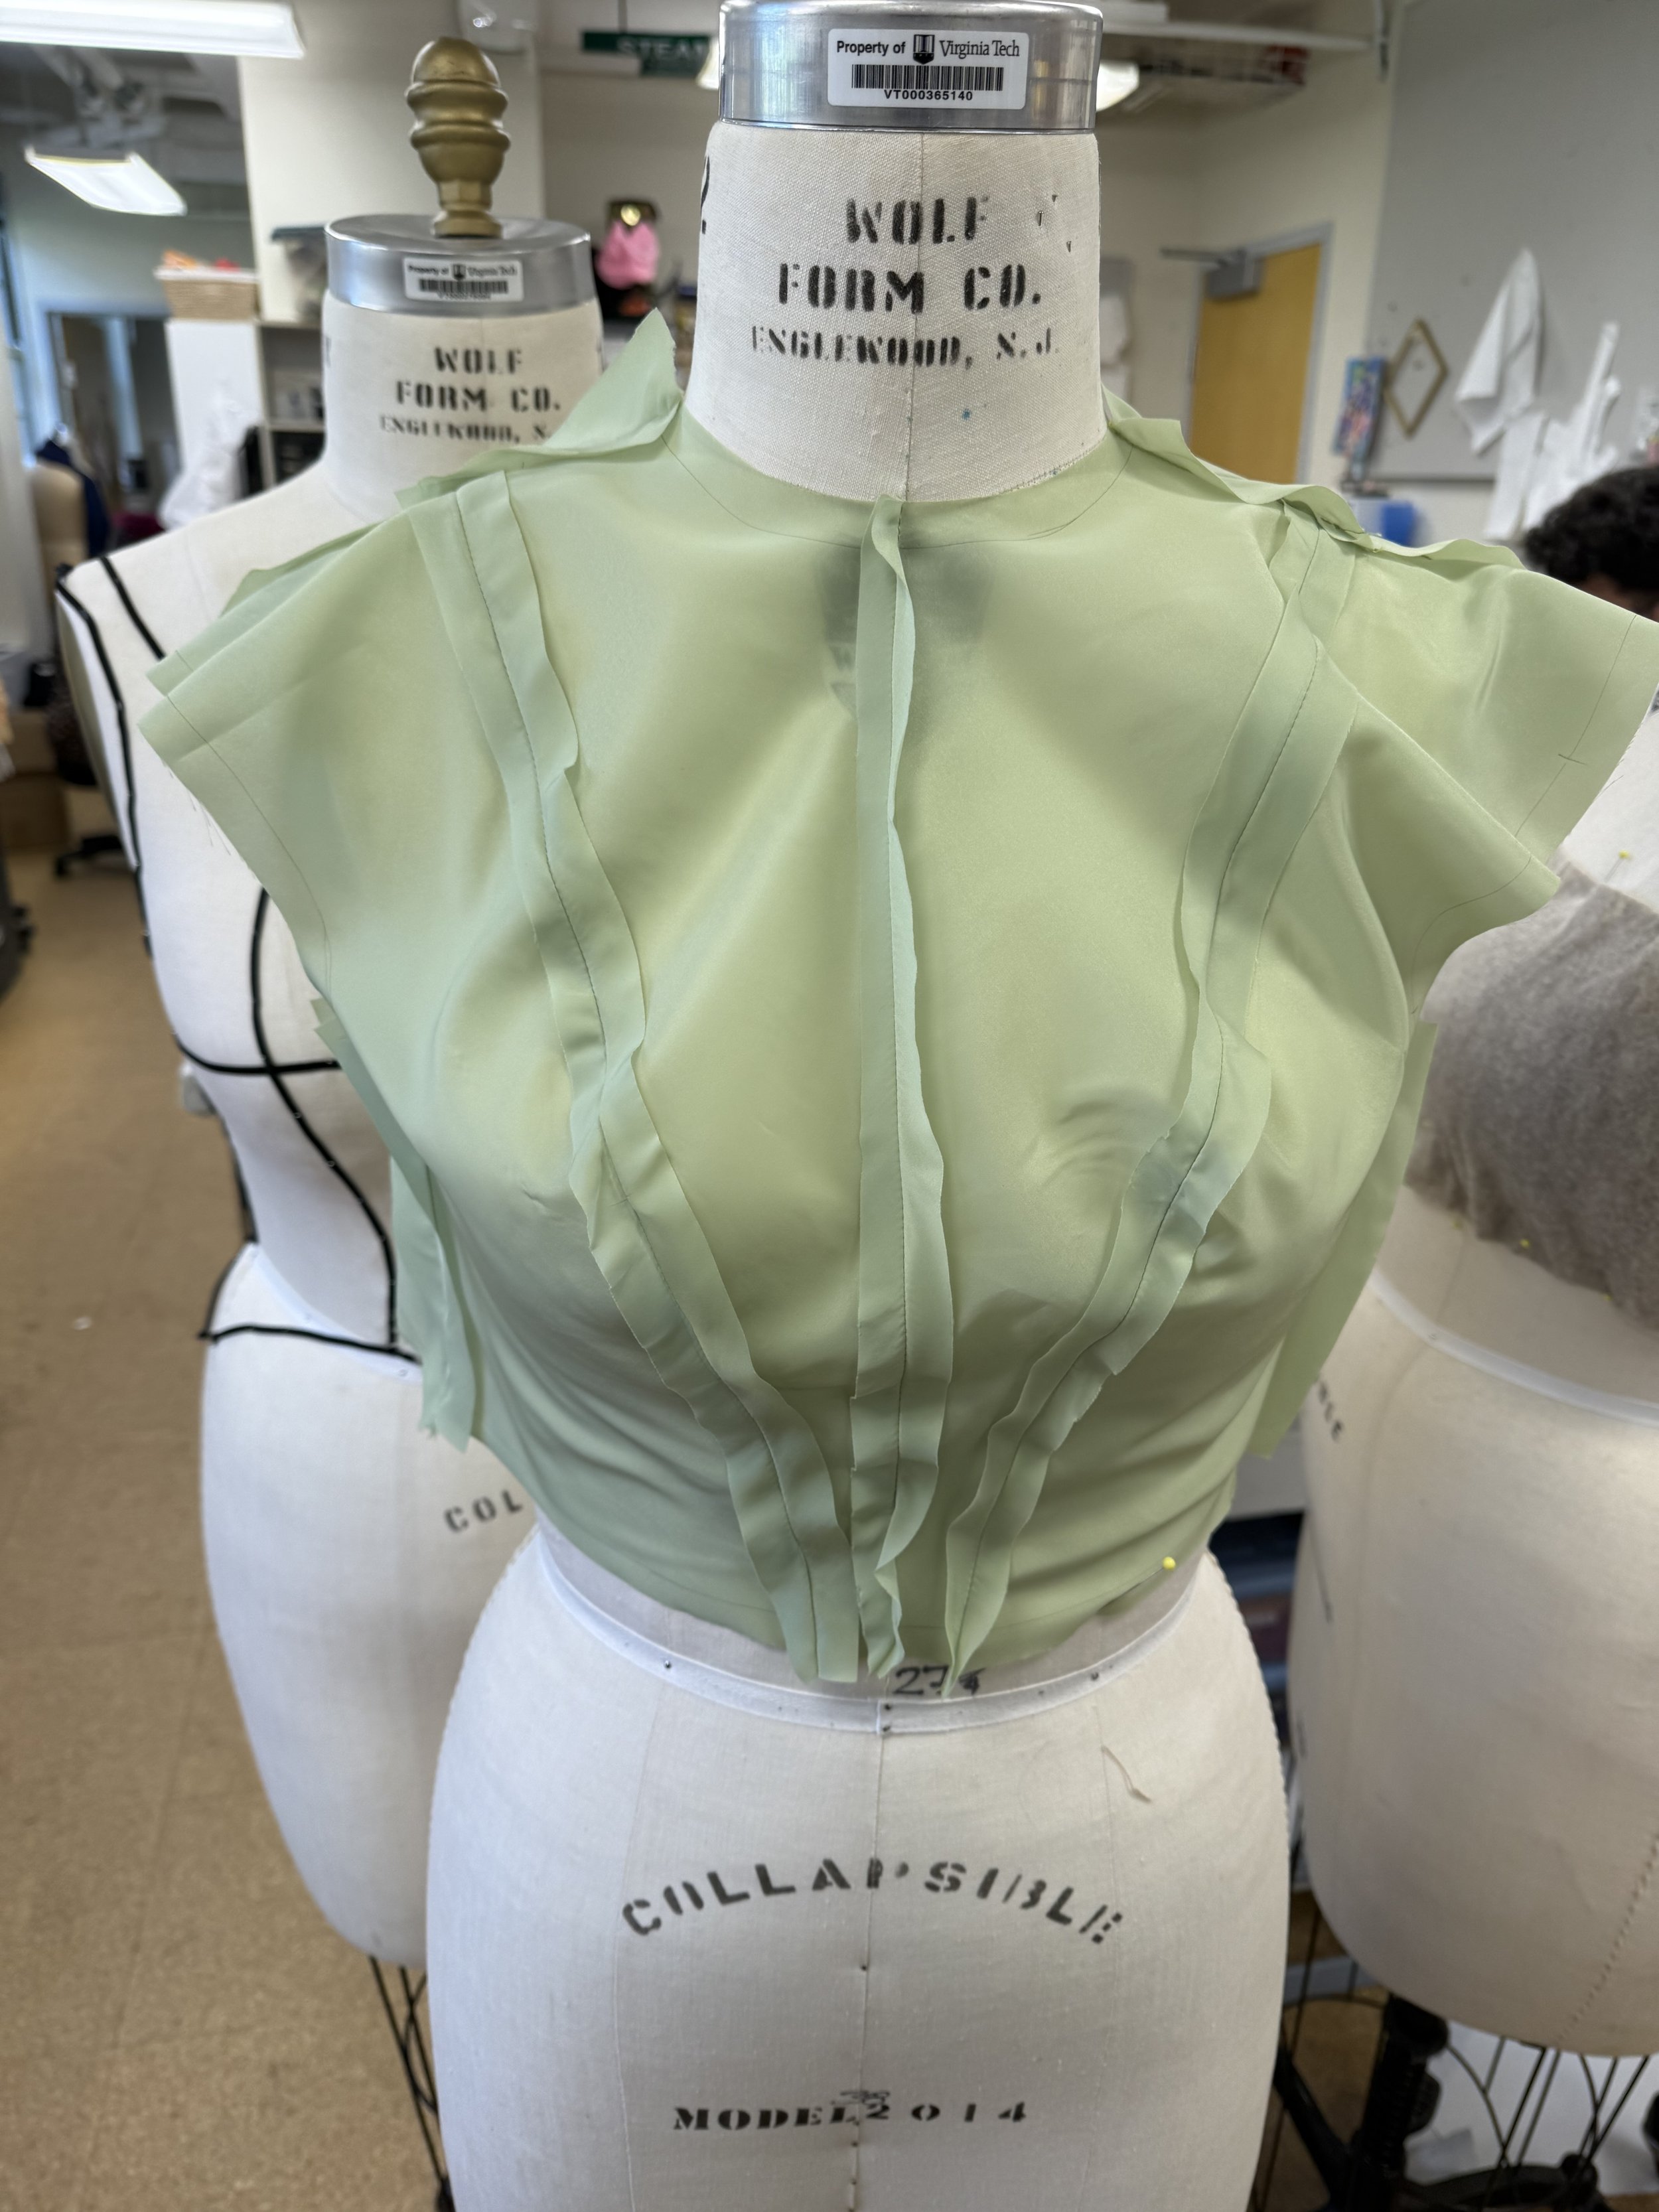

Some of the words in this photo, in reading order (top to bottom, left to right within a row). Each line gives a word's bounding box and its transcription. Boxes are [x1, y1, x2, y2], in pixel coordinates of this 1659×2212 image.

[836, 40, 889, 56] Property
[893, 41, 906, 54] of
[939, 40, 989, 60] Virginia
[991, 39, 1020, 57] Tech
[884, 89, 974, 101] VT000365140
[845, 197, 989, 245] WOLF
[778, 263, 924, 315] FORM
[964, 264, 1041, 311] CO.
[434, 346, 522, 374] WOLF
[752, 325, 974, 370] ENGLEWOOD,
[396, 380, 486, 412] FORM
[510, 387, 561, 412] CO.
[621, 1858, 1123, 1945] COLLAPSIBLE
[673, 2106, 860, 2130] MODEL
